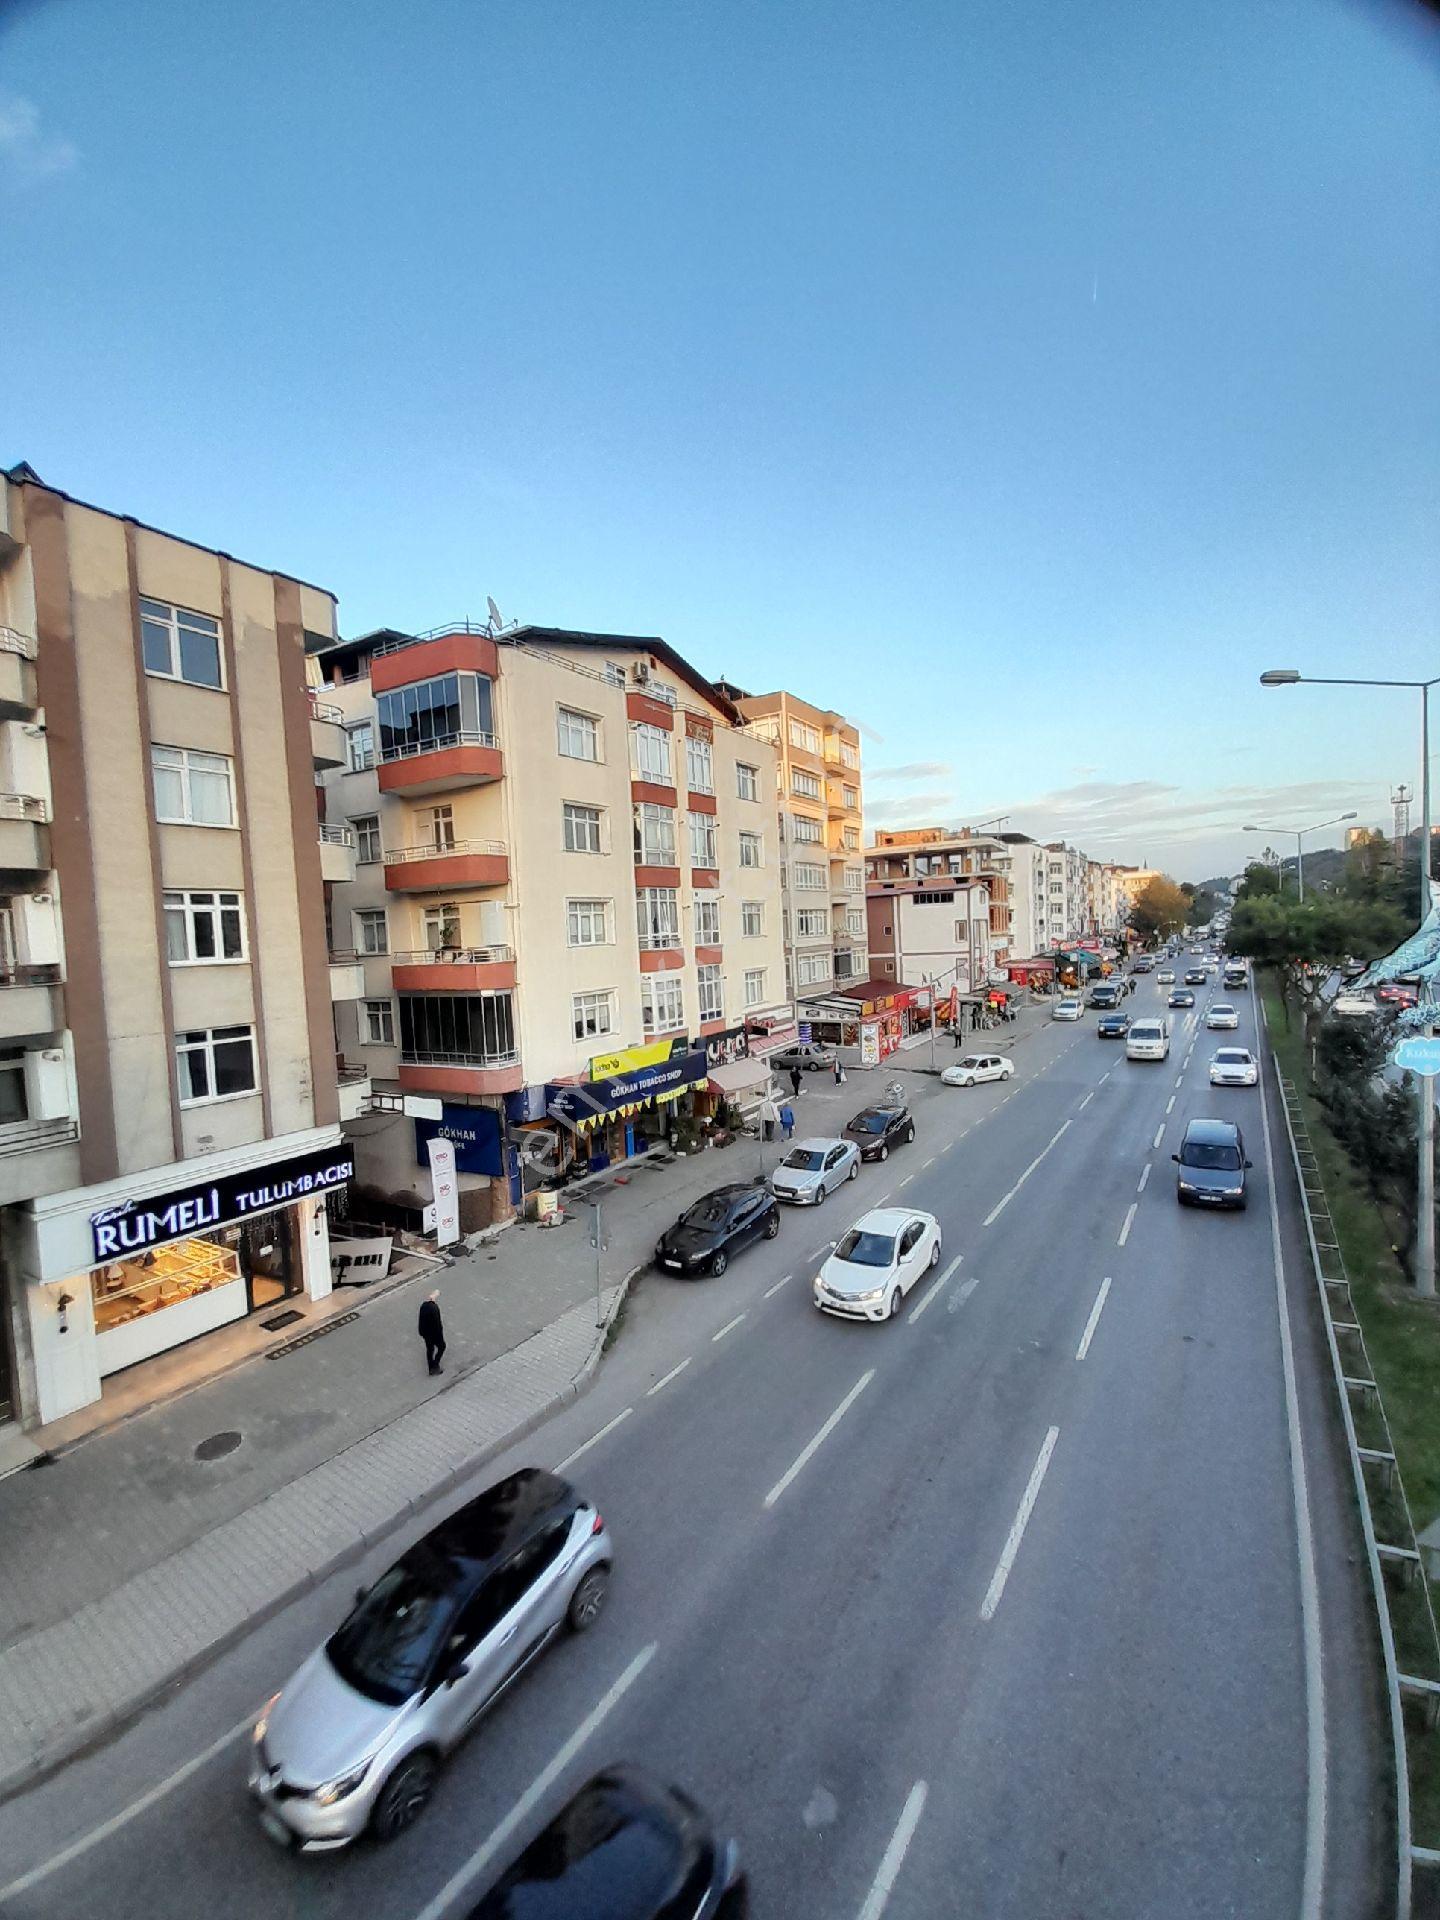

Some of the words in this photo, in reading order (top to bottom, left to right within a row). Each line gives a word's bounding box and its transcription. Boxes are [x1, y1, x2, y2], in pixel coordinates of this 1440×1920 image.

[639, 1073, 667, 1090] TOBACCO
[667, 1069, 682, 1081] SHOP
[438, 1125, 476, 1141] GÖKHAN
[96, 1189, 220, 1256] RUMELİ
[235, 1161, 353, 1211] TULUMBACISI
